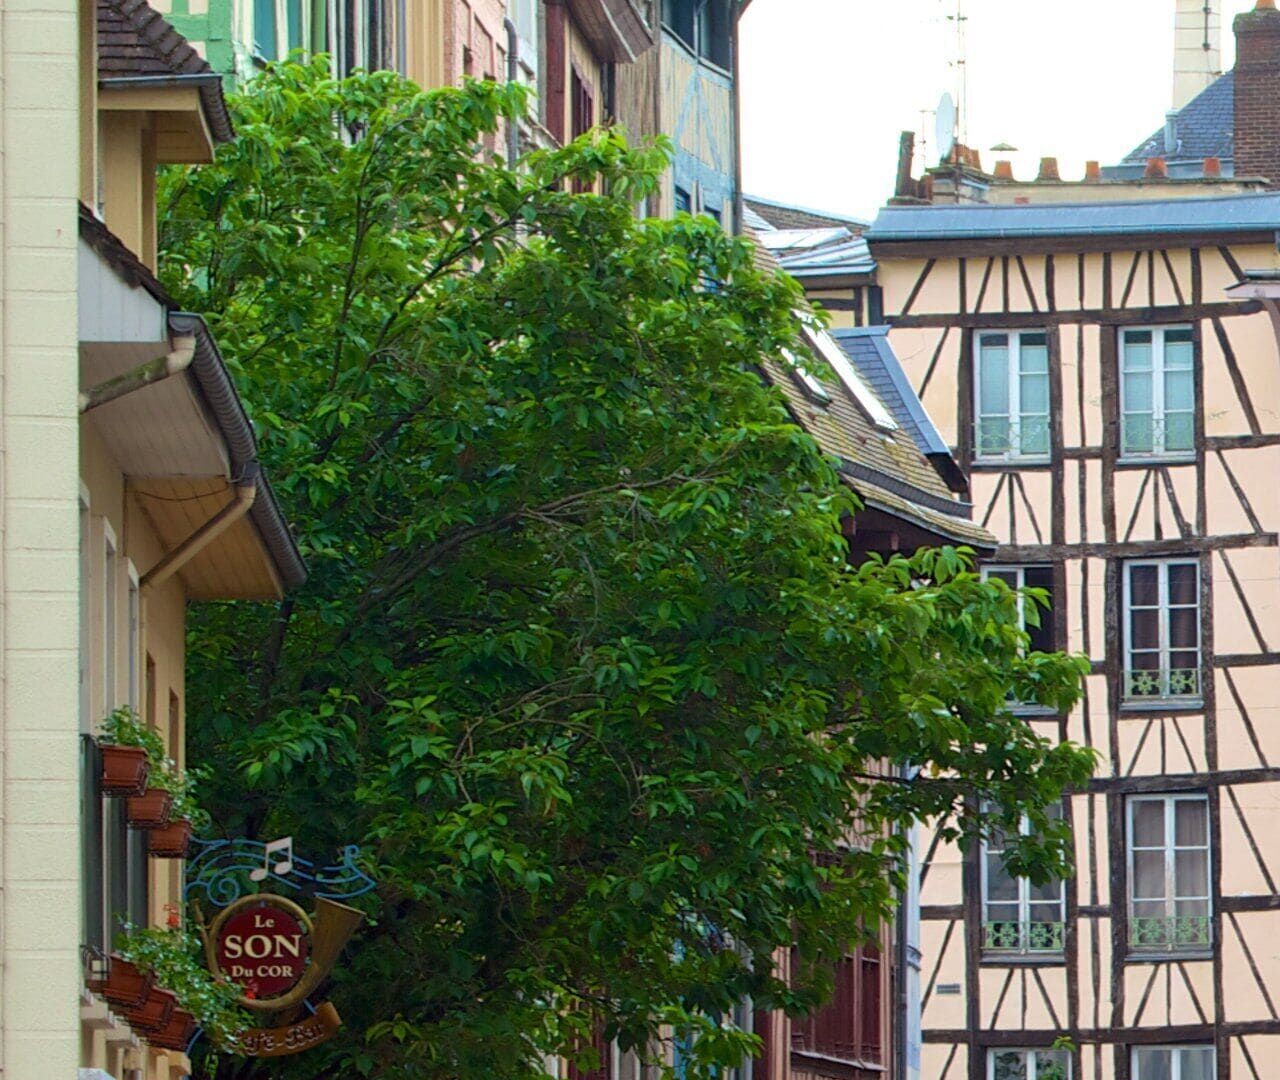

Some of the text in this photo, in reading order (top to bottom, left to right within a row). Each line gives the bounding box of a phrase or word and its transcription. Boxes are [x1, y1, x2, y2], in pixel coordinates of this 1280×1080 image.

[254, 914, 275, 929] Le
[224, 934, 302, 959] SON
[232, 965, 293, 978] Du COR
